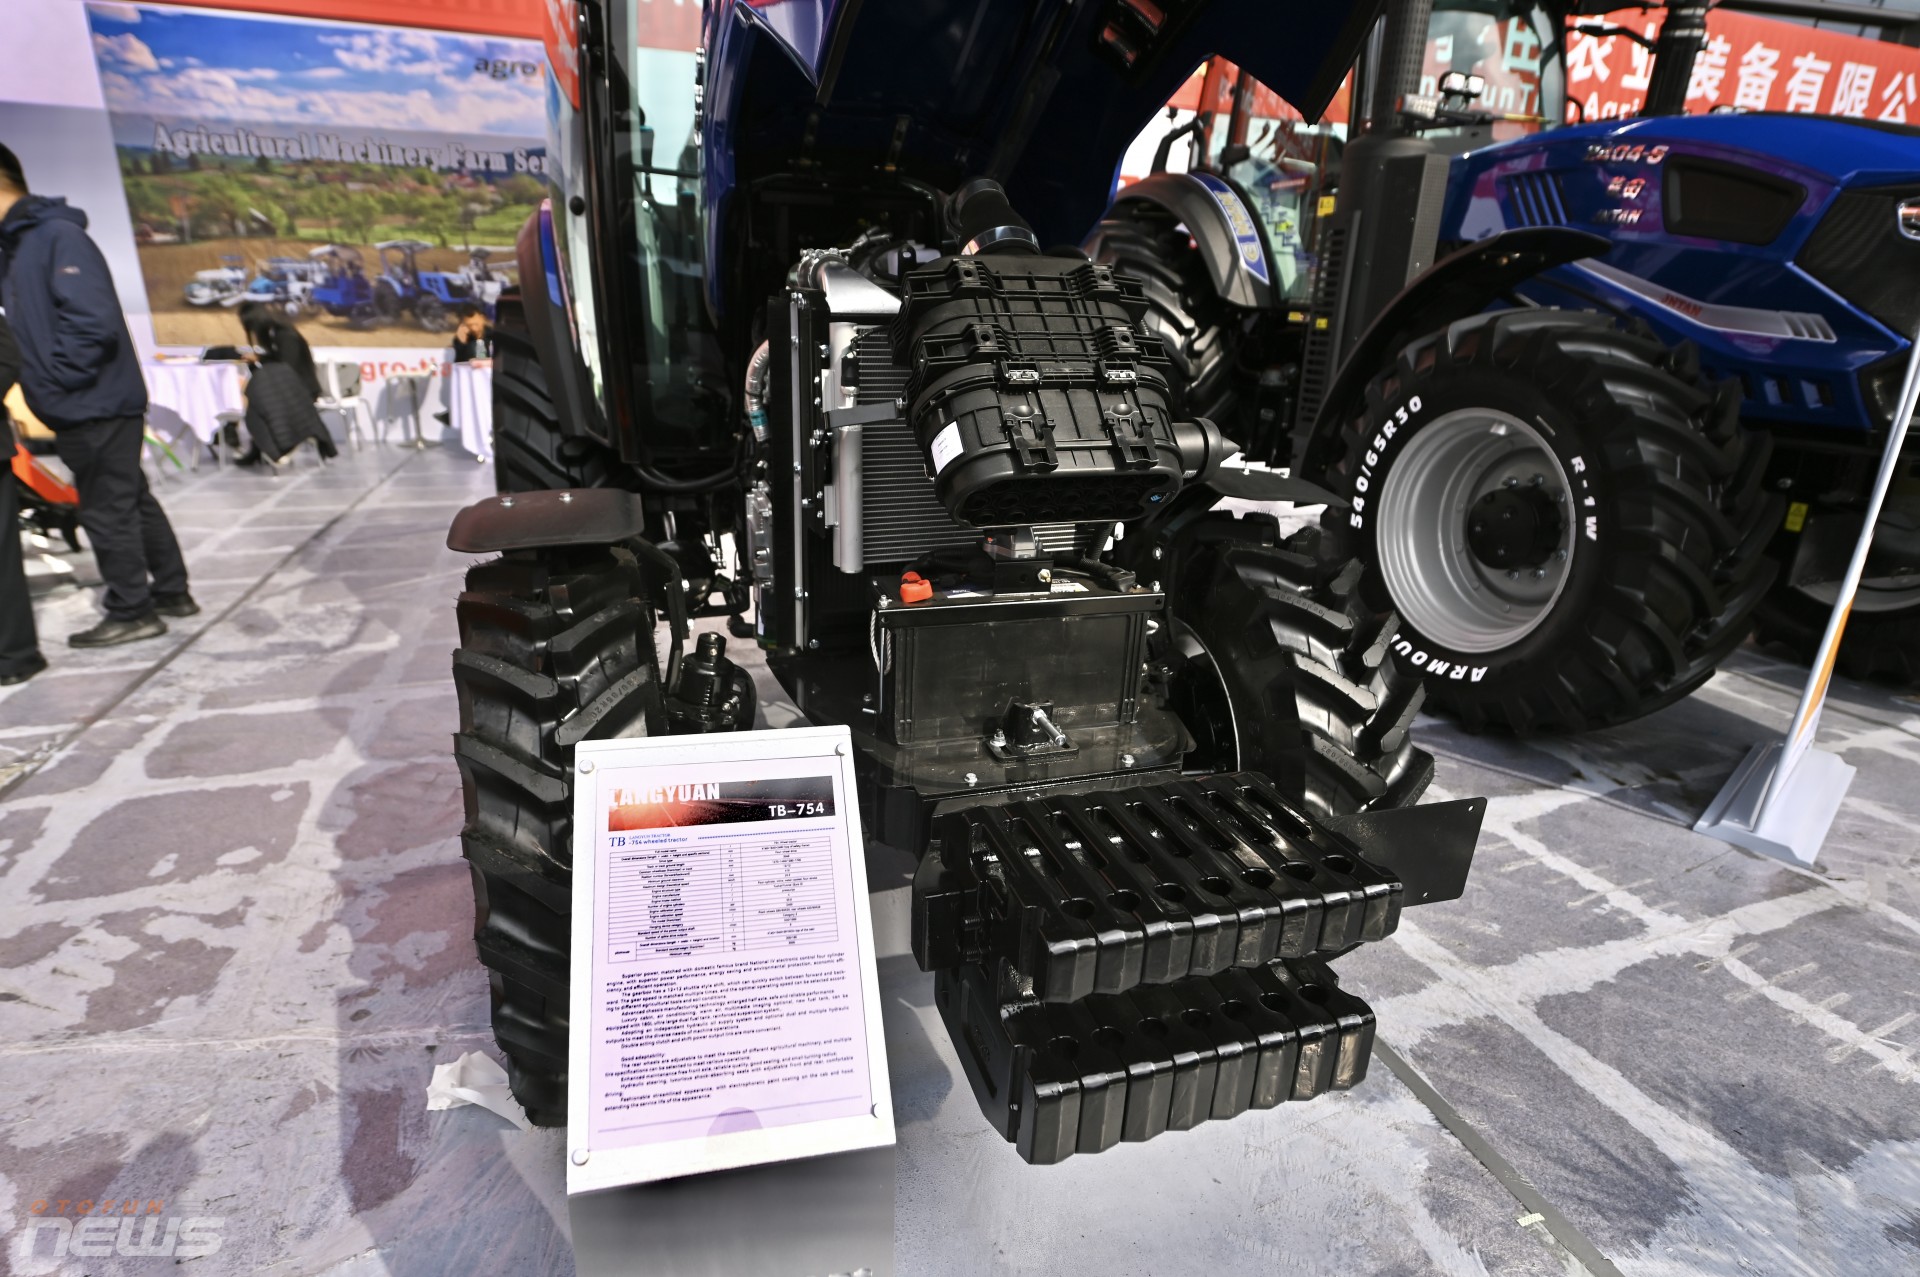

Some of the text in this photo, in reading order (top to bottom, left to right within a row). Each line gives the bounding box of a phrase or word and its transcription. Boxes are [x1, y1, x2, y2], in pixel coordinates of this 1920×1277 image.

[154, 121, 312, 159] Agricultural
[315, 132, 442, 173] Machinery
[447, 141, 508, 171] Farm
[1350, 395, 1423, 529] 540/65R30
[608, 783, 720, 808] LANGYUAN
[768, 801, 825, 818] TB-754
[608, 836, 626, 847] TB
